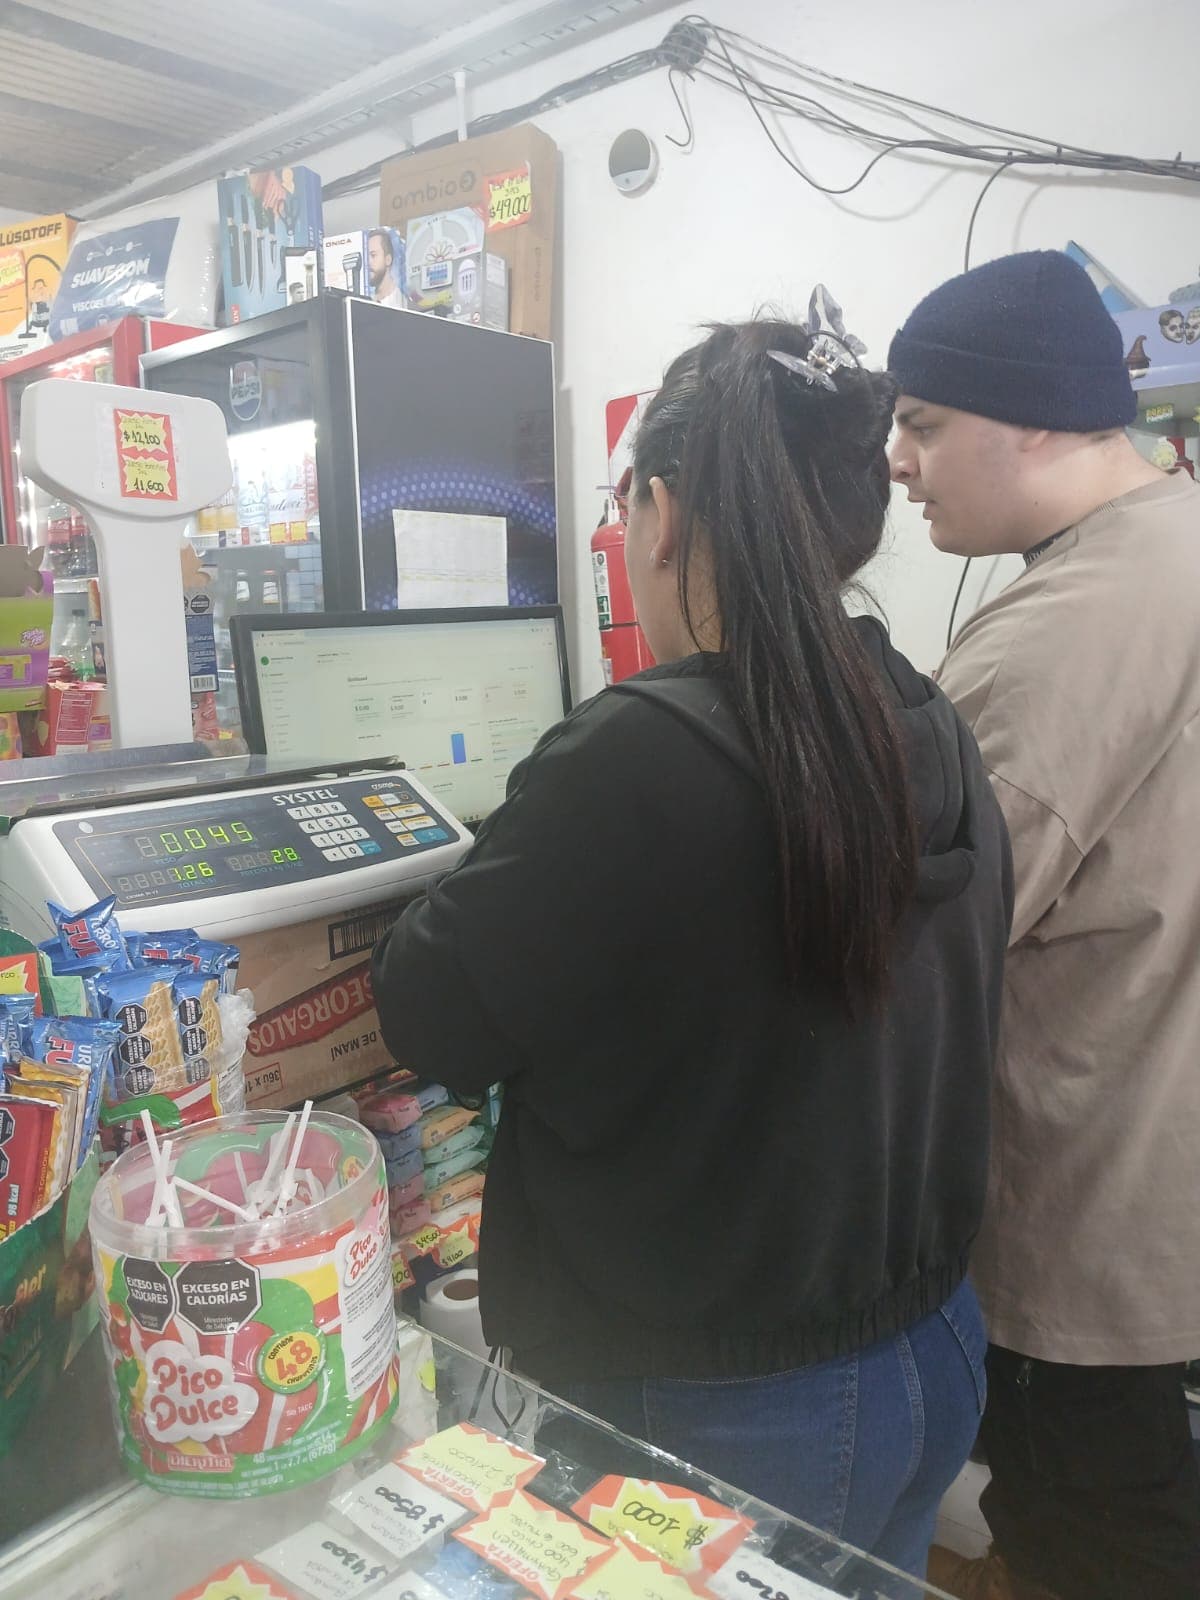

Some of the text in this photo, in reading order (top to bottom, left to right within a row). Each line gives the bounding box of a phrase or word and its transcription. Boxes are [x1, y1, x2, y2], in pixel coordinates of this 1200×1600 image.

[231, 383, 261, 400] PEPSI
[272, 788, 339, 806] SYSTEL
[160, 822, 253, 853] 0.045
[362, 1030, 378, 1048] DE
[9, 1184, 20, 1203] kcal
[126, 1276, 167, 1292] EXCESO EN
[182, 1278, 250, 1294] EXCESO EN
[186, 1290, 248, 1306] CALORÍAS
[275, 1340, 314, 1381] 48
[152, 1356, 224, 1397] Pico
[150, 1394, 239, 1432] Dulce
[423, 1466, 476, 1498] OFERTA
[374, 1486, 427, 1521] 8500
[622, 1500, 680, 1535] 1000
[683, 1525, 709, 1550] $
[486, 1543, 540, 1581] OFERTA
